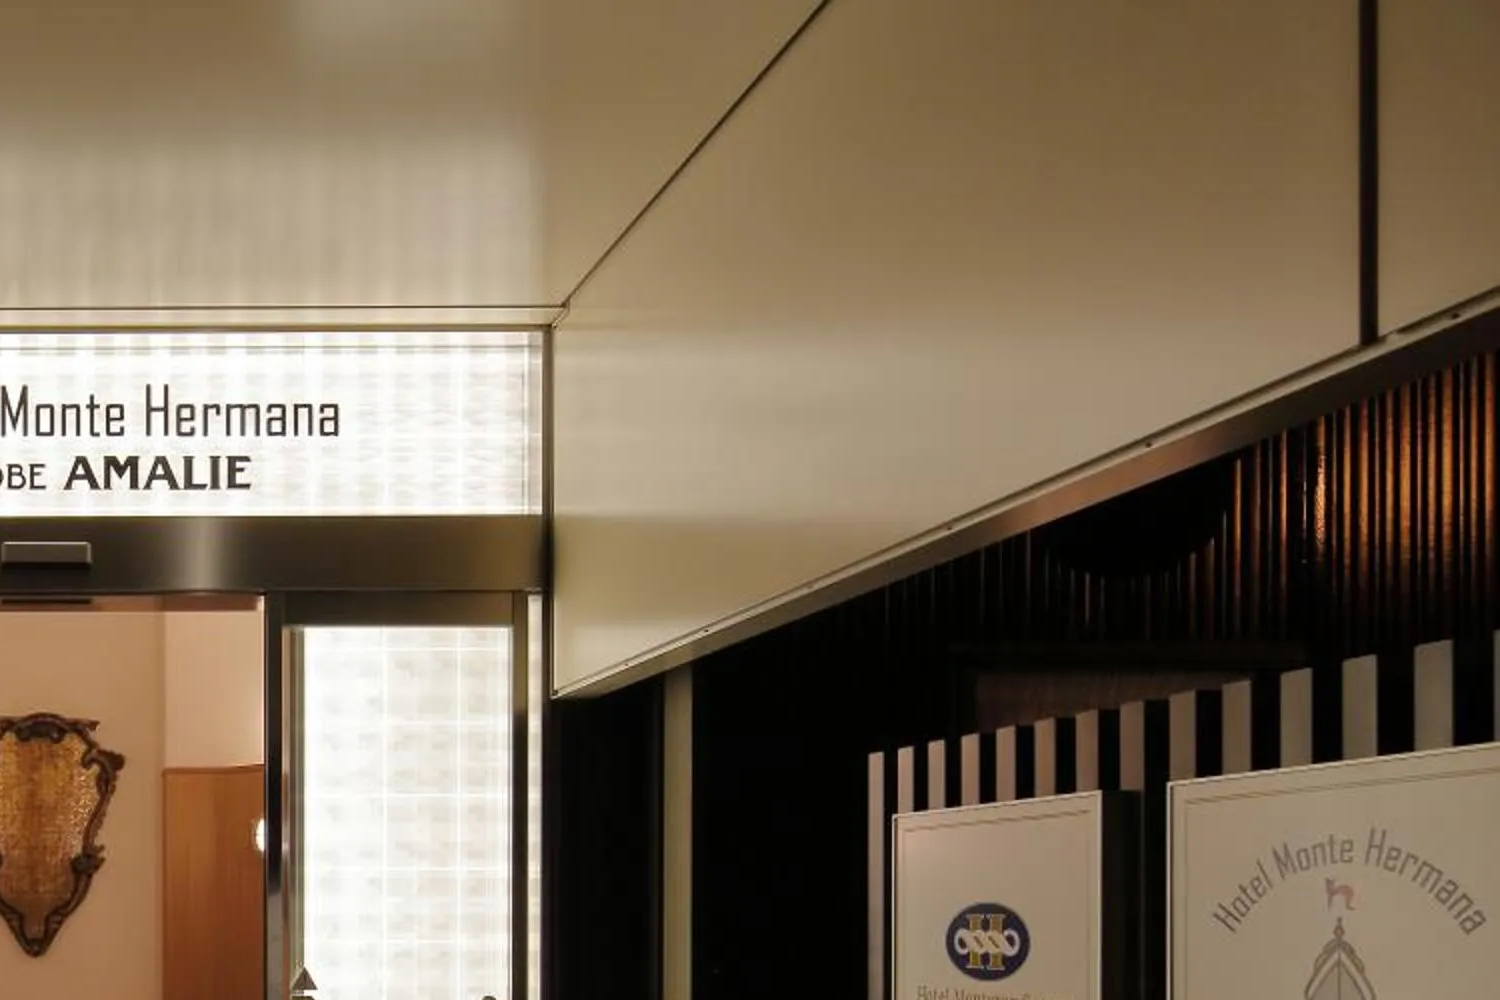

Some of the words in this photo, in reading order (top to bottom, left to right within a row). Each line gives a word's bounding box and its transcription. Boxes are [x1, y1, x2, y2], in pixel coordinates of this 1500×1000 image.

[0, 384, 126, 438] Monte
[145, 384, 340, 438] Hermana
[63, 455, 252, 491] AMALIE
[1211, 860, 1274, 935] Hotel
[1272, 833, 1355, 882] Monte
[1364, 827, 1488, 936] Hermana
